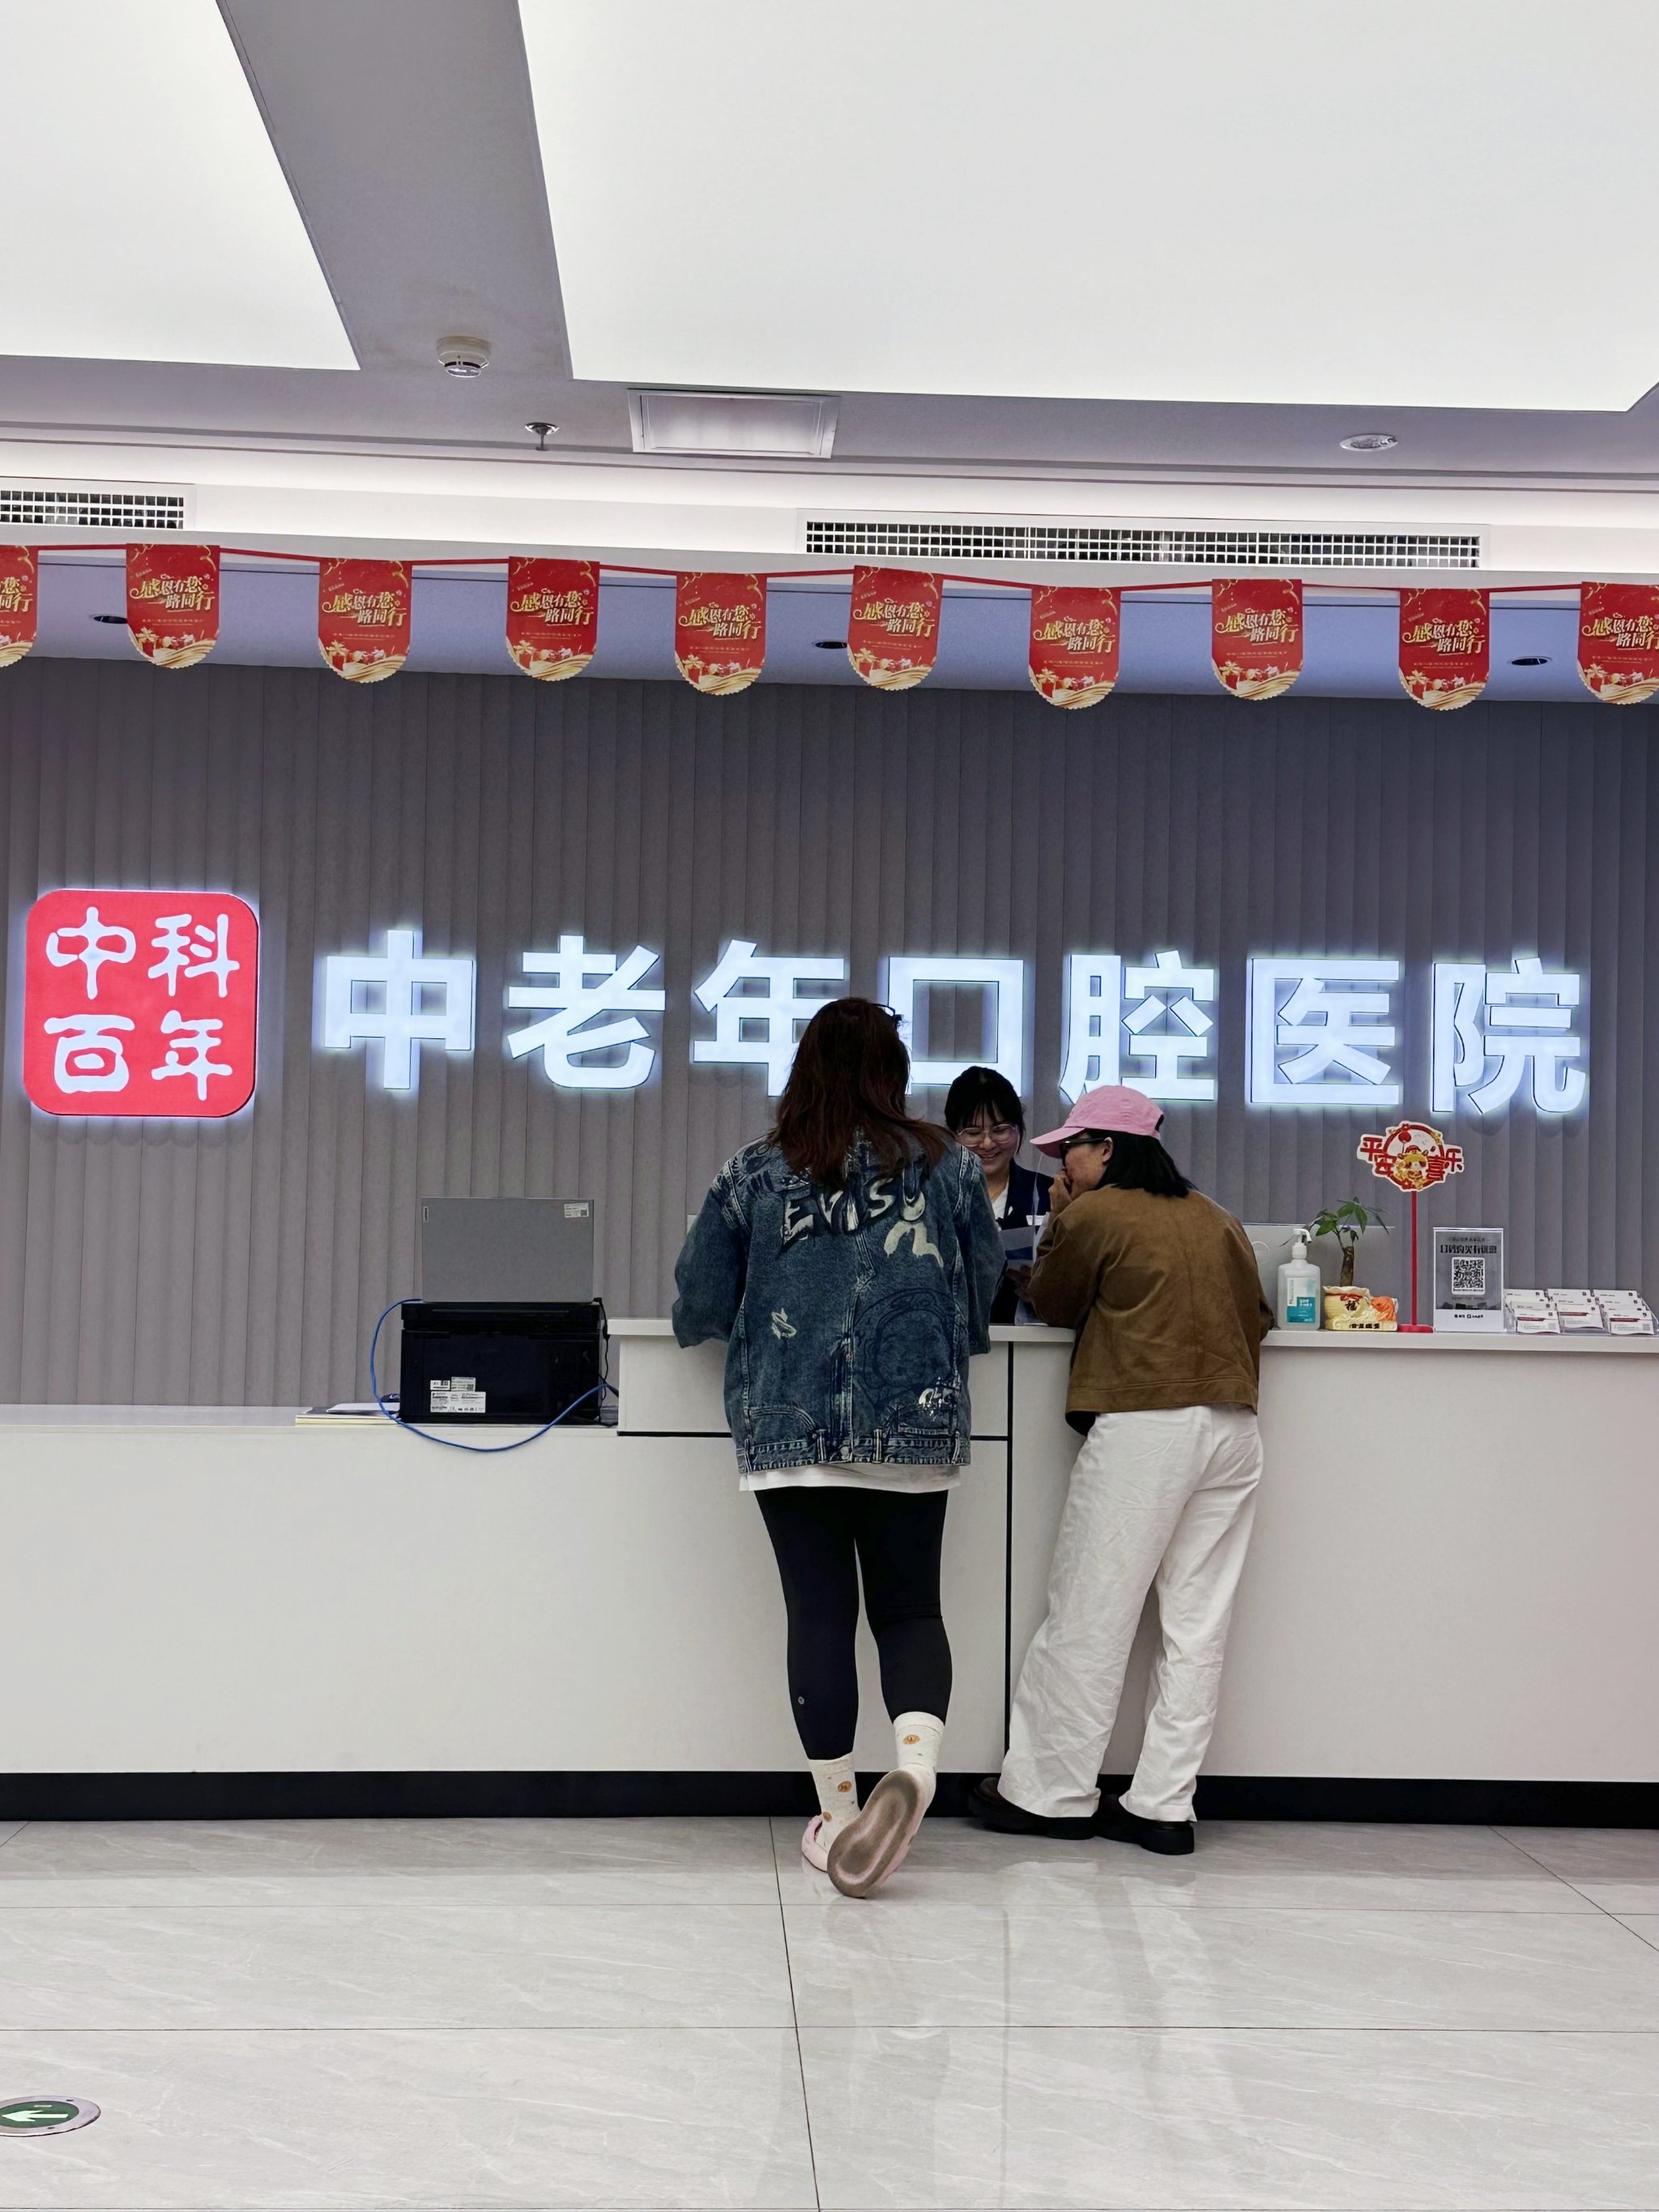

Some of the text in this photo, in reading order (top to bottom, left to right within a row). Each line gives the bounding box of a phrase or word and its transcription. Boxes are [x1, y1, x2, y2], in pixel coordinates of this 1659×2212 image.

[130, 575, 203, 599] 感恩有您
[148, 590, 215, 611] 一路同行
[322, 591, 394, 613] 感恩有您
[510, 590, 583, 612] 感恩有您
[853, 601, 925, 620] 感恩有您
[340, 606, 407, 627] 一路同行
[528, 605, 595, 626] 一路同行
[679, 604, 750, 627] 感恩有您
[1215, 608, 1286, 633] 感恩有您
[1581, 615, 1653, 637] 感恩有您
[696, 620, 761, 640] 一路同行
[869, 618, 935, 637] 一路同行
[1033, 618, 1104, 641] 感恩有您
[1232, 624, 1299, 643] 一路同行
[1401, 619, 1473, 643] 感恩有您
[1050, 633, 1115, 654] 一路同行
[1420, 635, 1486, 654] 一路同行
[46, 906, 241, 999] 中科
[323, 929, 1588, 1115] 中老年口腔医院
[44, 1010, 233, 1101] 百年
